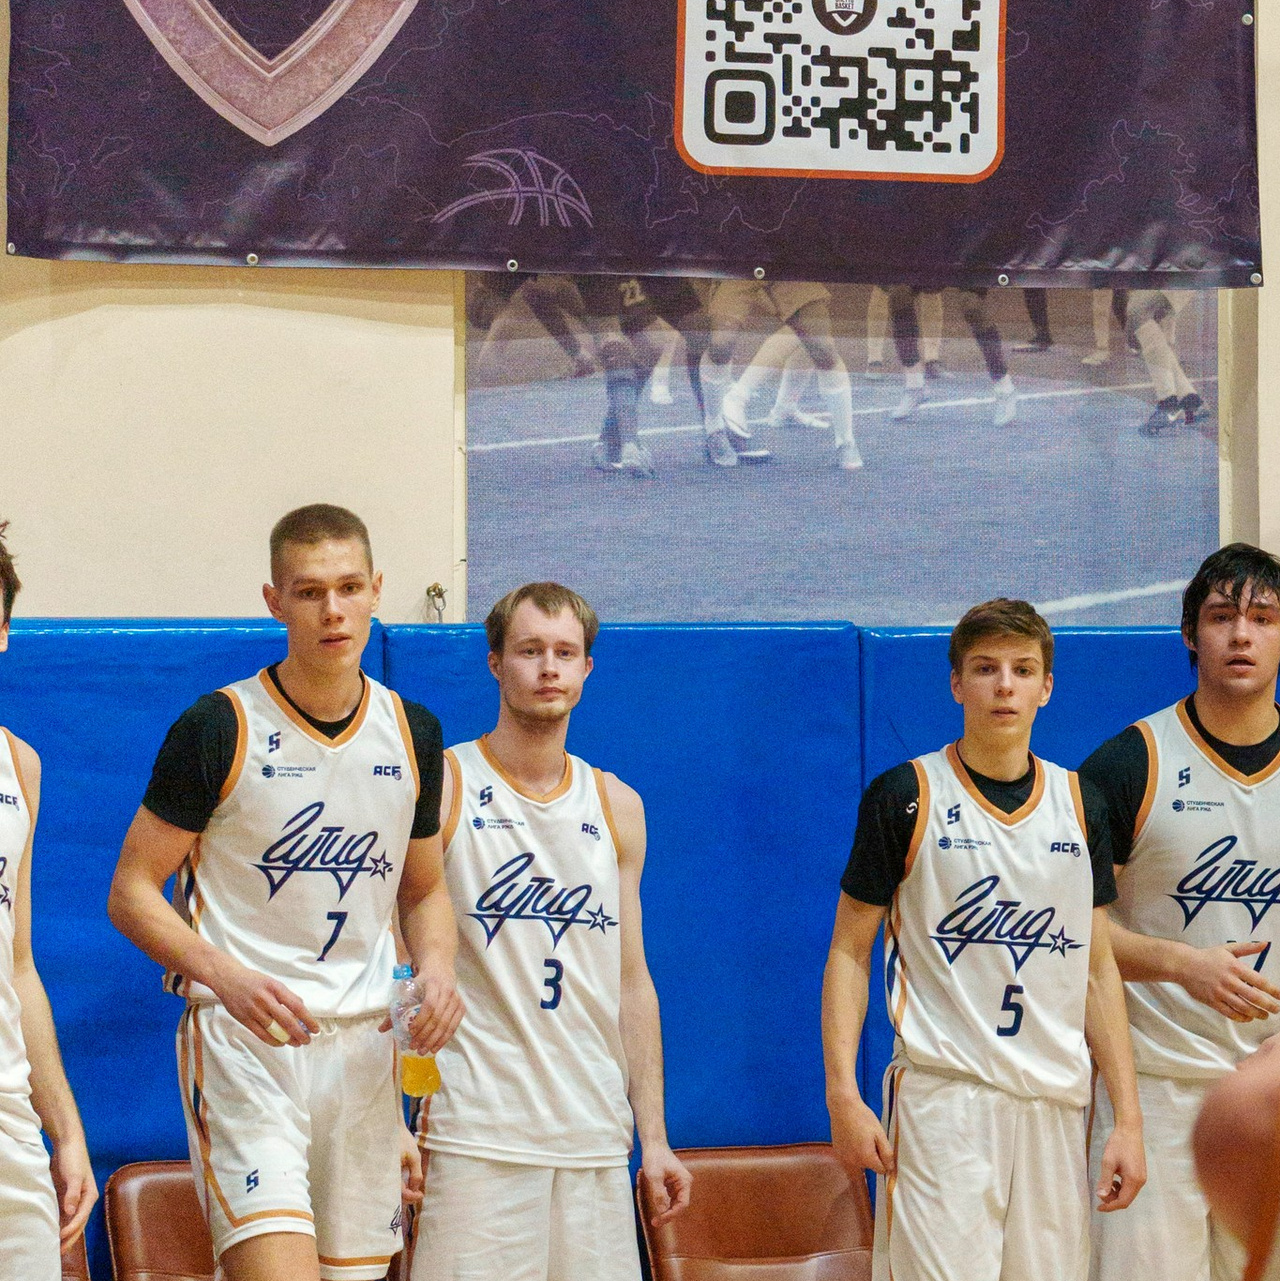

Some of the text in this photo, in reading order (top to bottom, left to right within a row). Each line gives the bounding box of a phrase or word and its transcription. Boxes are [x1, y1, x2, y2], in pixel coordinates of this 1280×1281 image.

[316, 911, 348, 962] 7
[540, 958, 564, 1010] 3
[996, 984, 1024, 1037] 5
